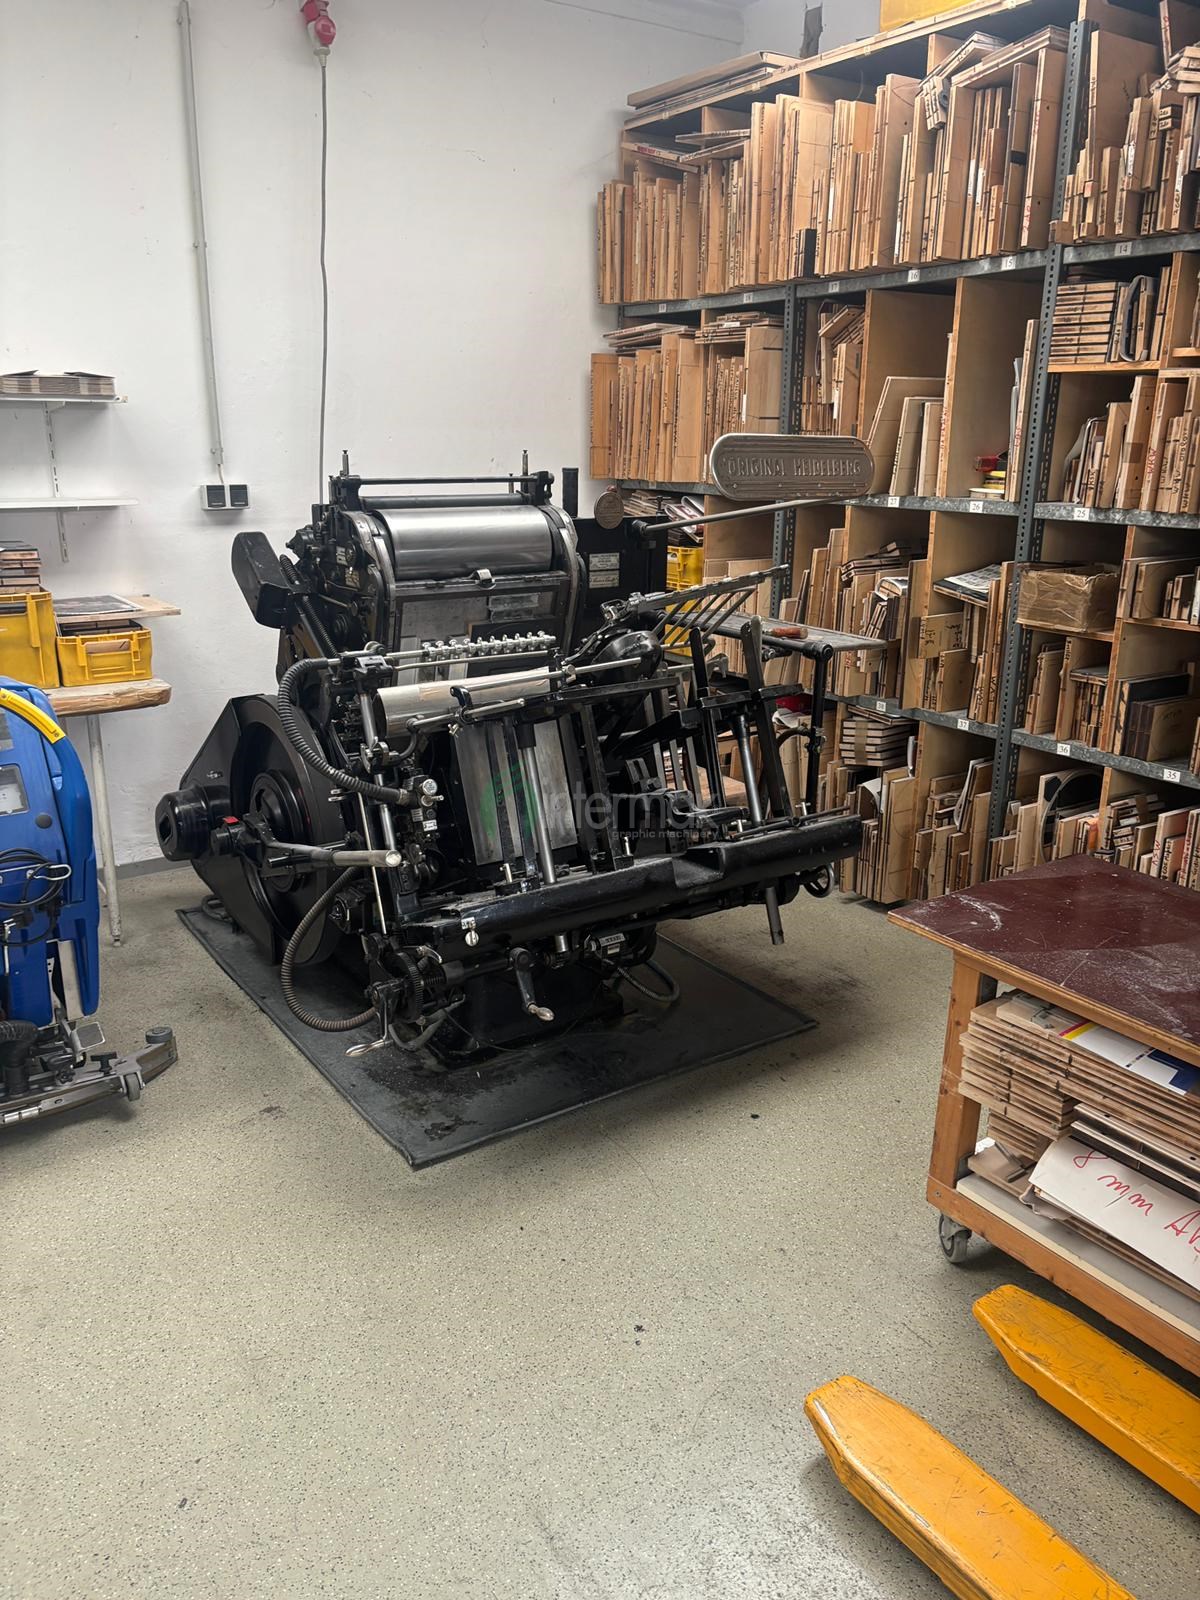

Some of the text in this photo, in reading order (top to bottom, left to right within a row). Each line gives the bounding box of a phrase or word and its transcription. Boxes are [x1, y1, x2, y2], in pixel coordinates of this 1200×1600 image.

[1119, 243, 1128, 253] 14
[1005, 257, 1014, 267] 15
[726, 455, 862, 477] ORIGINAL HEIDELBERG
[1077, 510, 1086, 518] 25
[1167, 771, 1177, 780] 35
